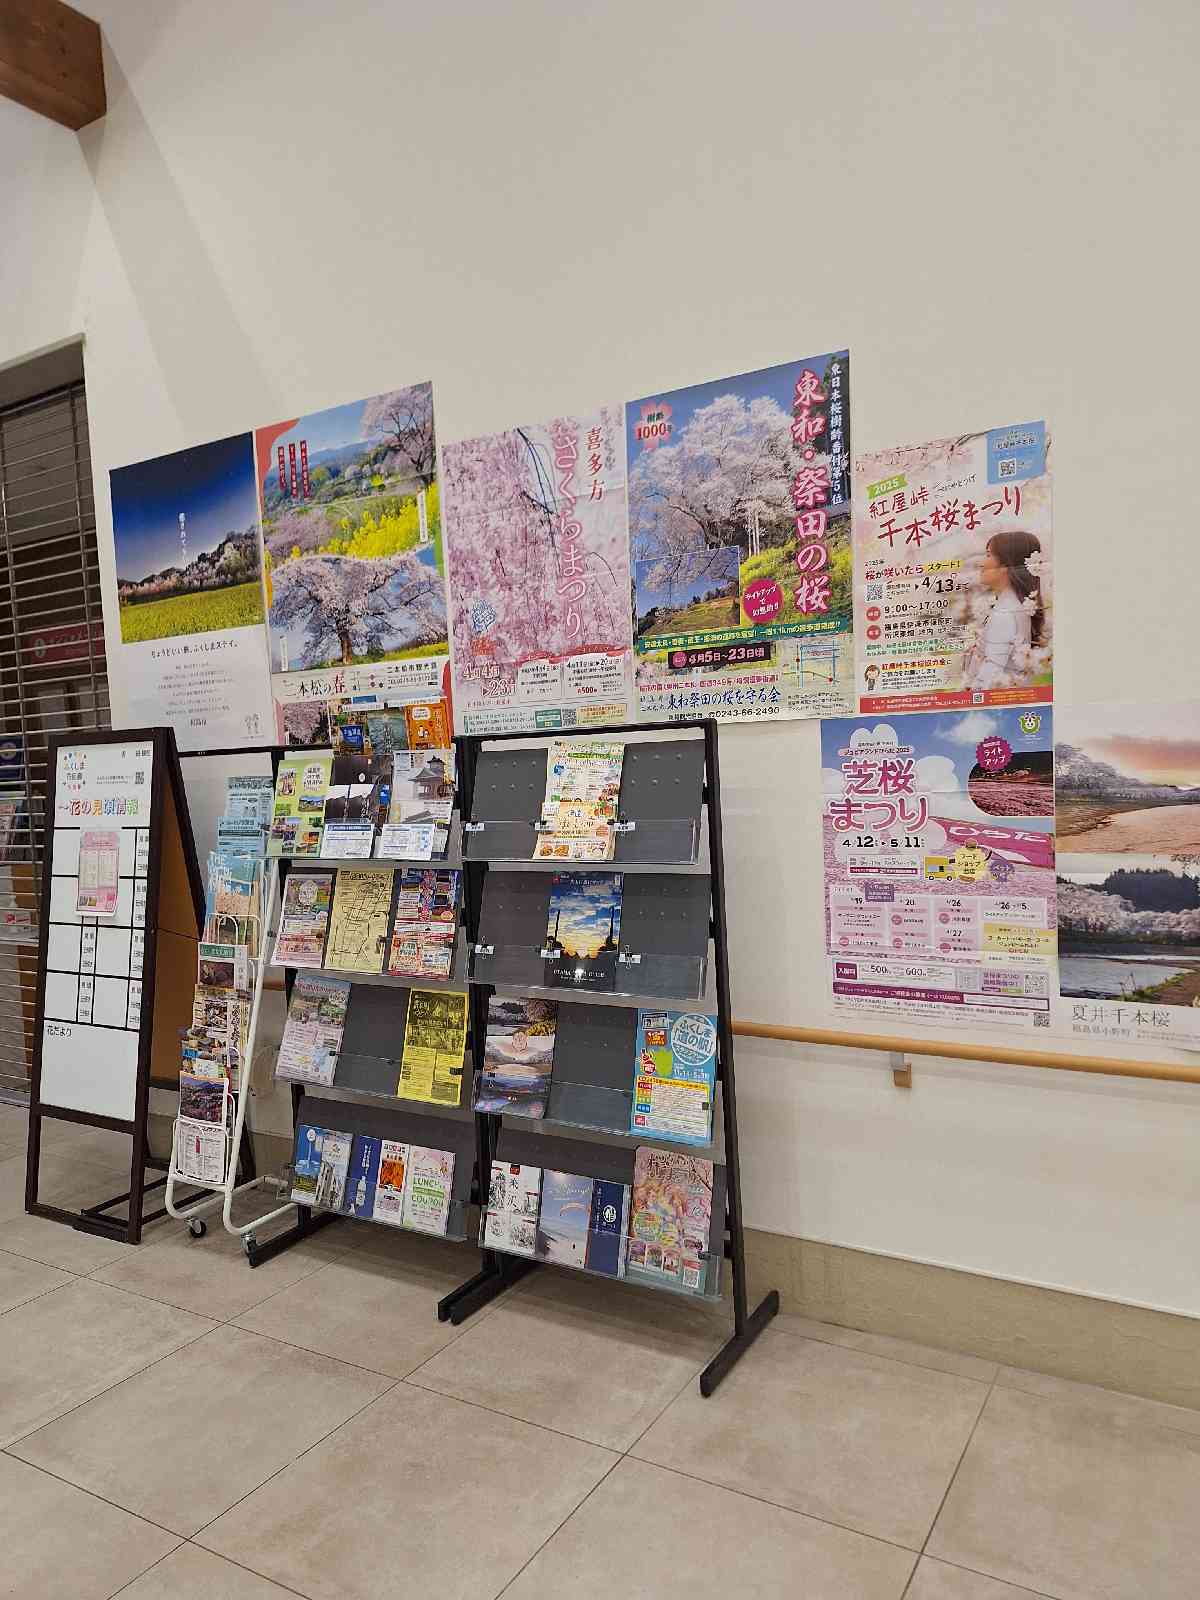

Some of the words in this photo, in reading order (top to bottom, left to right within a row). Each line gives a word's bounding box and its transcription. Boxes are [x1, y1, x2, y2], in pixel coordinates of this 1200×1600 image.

[585, 426, 605, 501] 喜多方
[791, 369, 834, 614] 東和・祭田の桜
[868, 485, 929, 519] 紅屋峠
[873, 477, 900, 496] 2025
[877, 485, 1022, 547] 千本桜まつり
[554, 436, 587, 639] さくらまつり
[864, 565, 925, 582] 桜が咲いたら
[667, 685, 782, 711] 東和祭田の桜を守る会
[984, 748, 1003, 758] ライト
[984, 756, 1005, 766] アップ
[842, 758, 915, 797] 芝桜
[829, 797, 928, 832] まつり
[1072, 1004, 1171, 1028] 夏井千本桜
